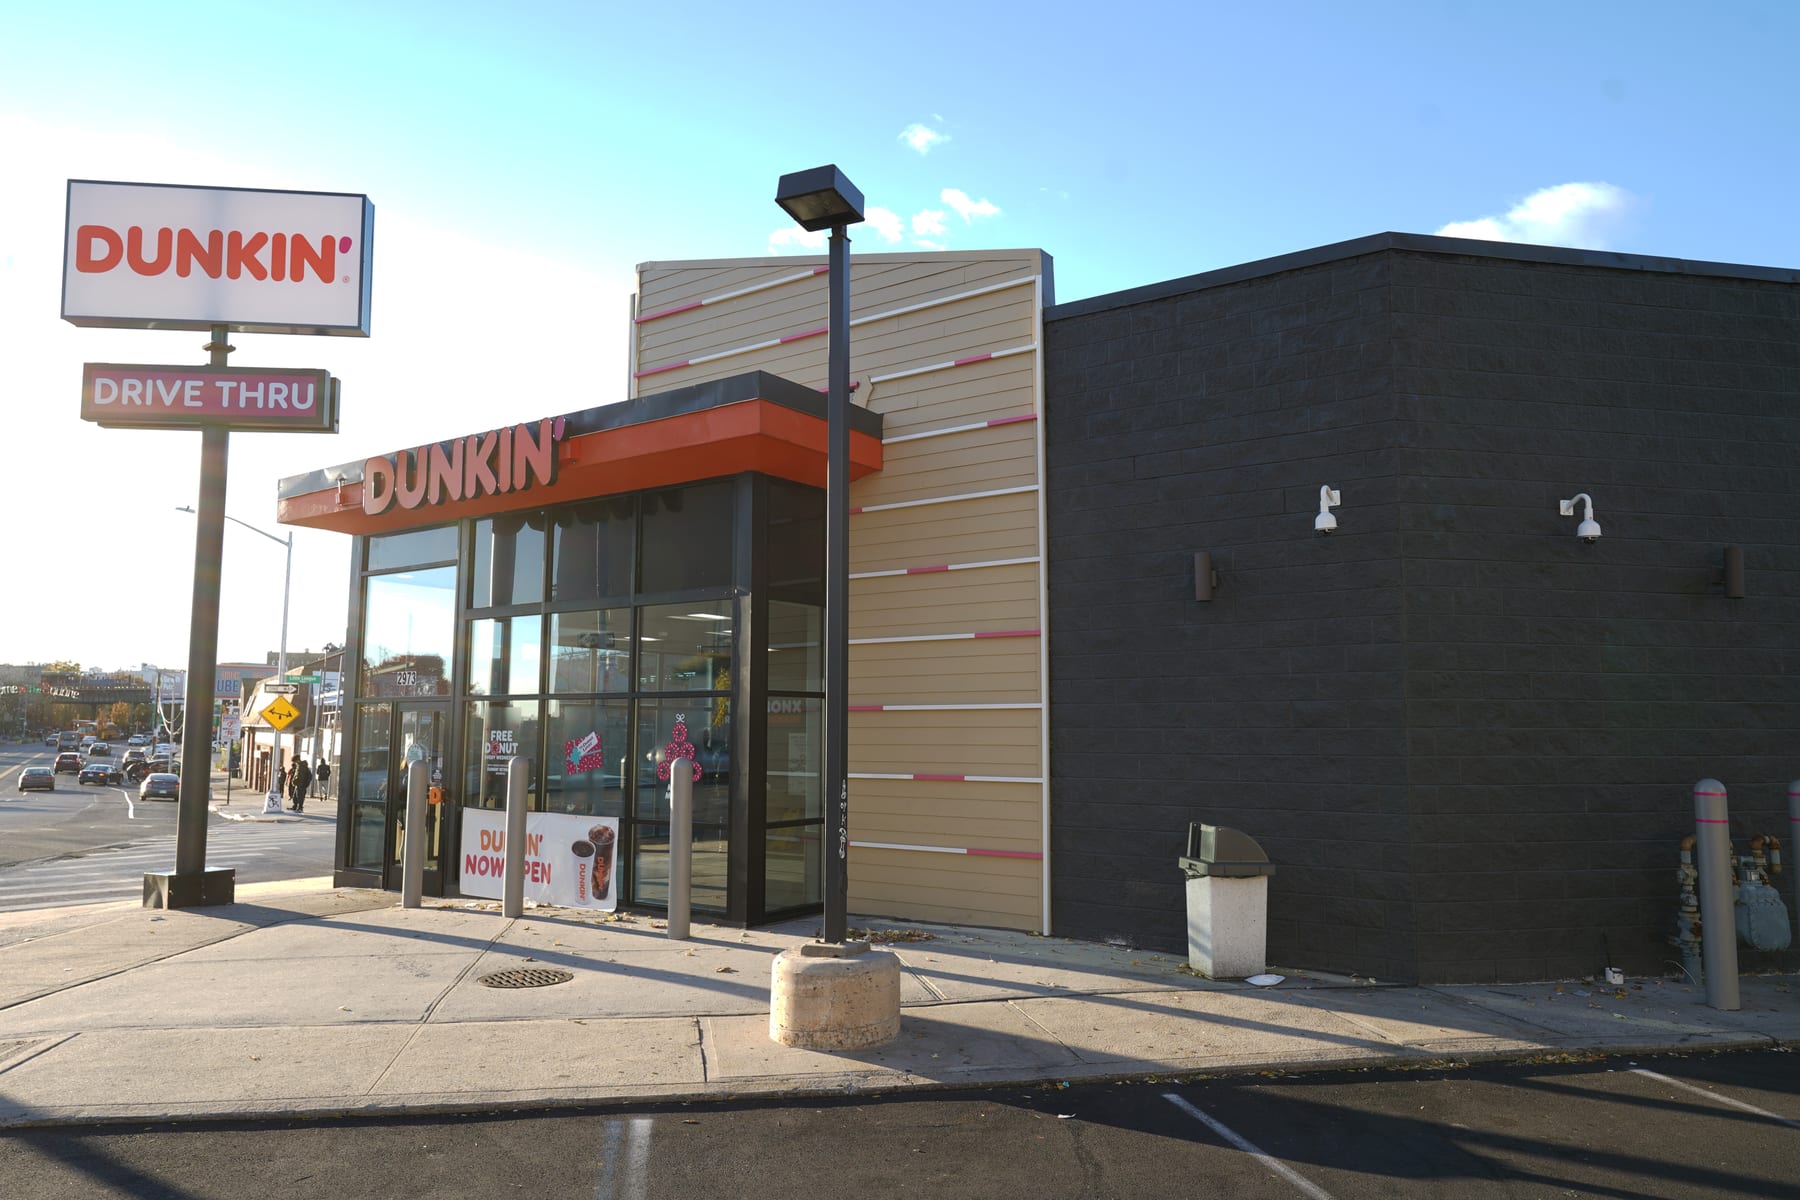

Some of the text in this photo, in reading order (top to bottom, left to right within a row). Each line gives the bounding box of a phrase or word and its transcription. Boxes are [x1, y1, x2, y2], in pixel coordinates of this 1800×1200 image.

[75, 224, 353, 284] DUNKIN'
[94, 378, 314, 410] DRIVE THRU
[363, 415, 566, 516] DUNKIN'
[397, 672, 416, 685] 2973
[767, 700, 801, 713] ONX
[485, 741, 519, 756] DONUT
[490, 730, 513, 741] FREE
[480, 829, 543, 857] DUIN'
[465, 854, 552, 885] NOW PEN
